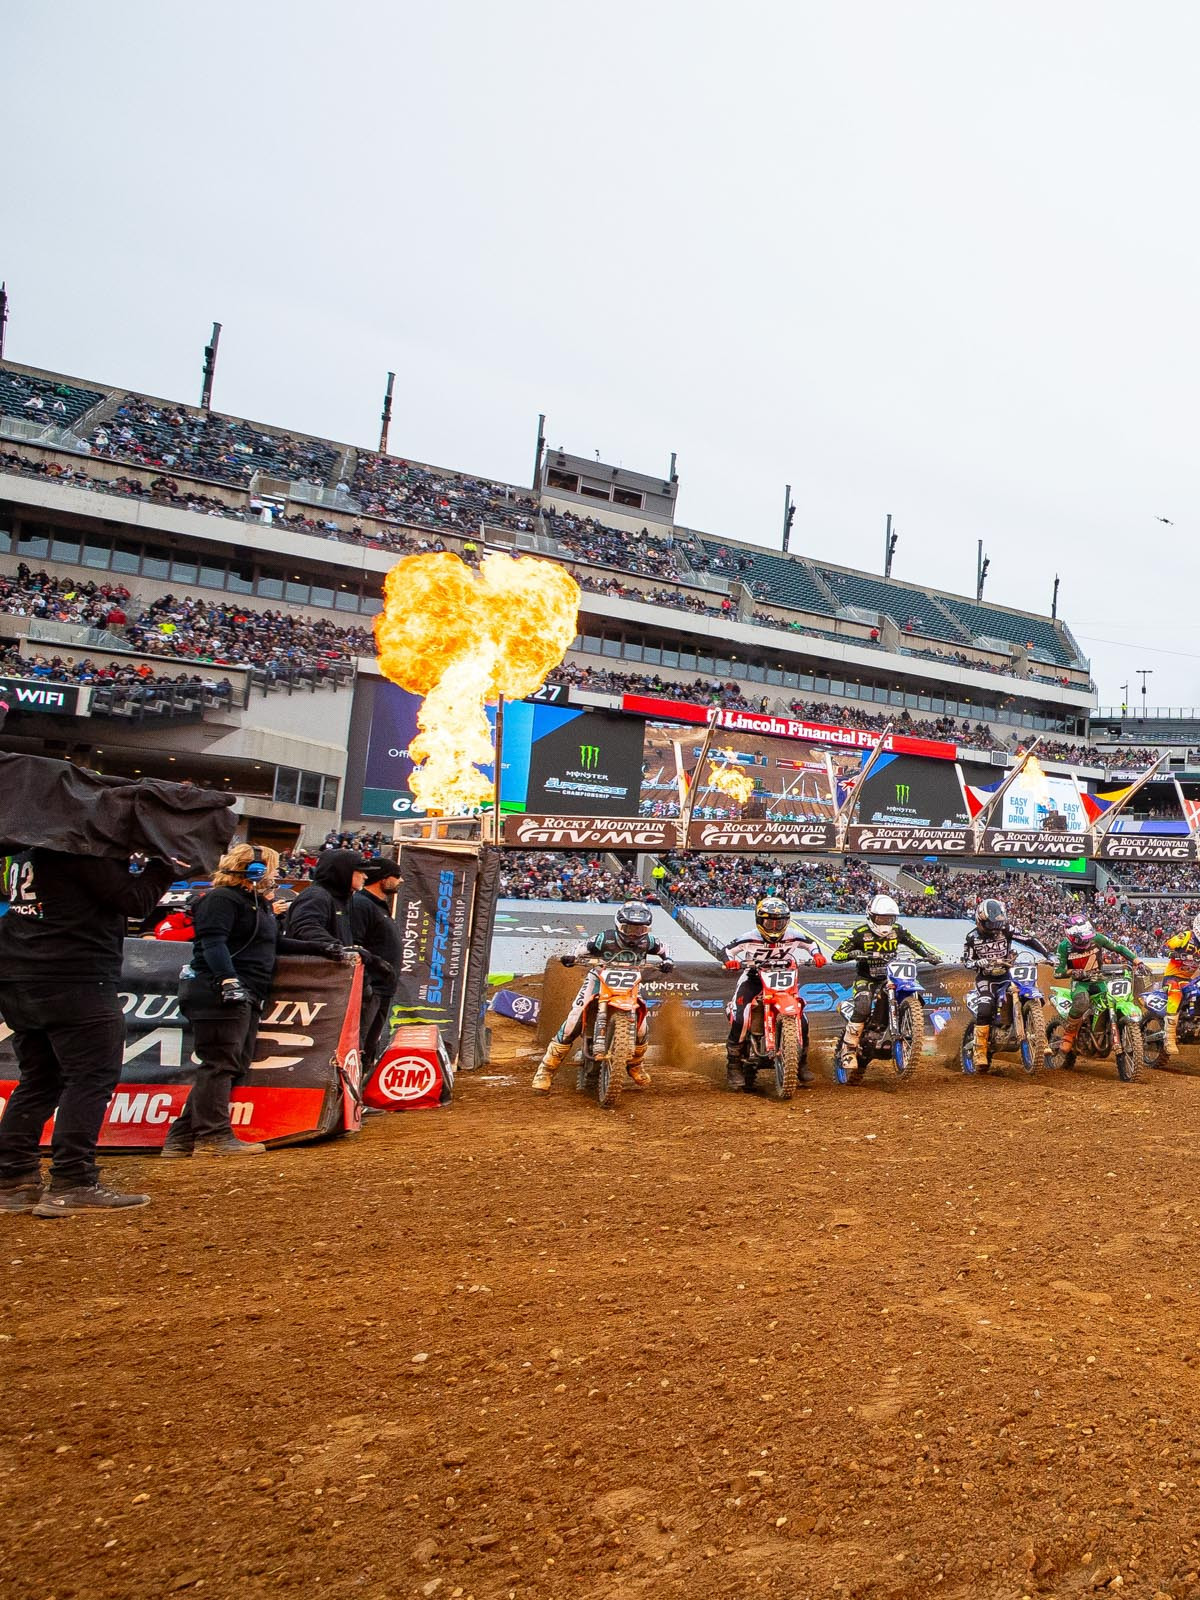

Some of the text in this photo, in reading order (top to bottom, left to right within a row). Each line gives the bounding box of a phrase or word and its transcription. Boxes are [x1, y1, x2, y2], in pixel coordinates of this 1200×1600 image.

[16, 688, 65, 706] WIFI
[724, 711, 786, 734] Lincoln
[787, 721, 856, 744] Financial
[562, 789, 610, 799] CHAMPIONSHIP
[1010, 796, 1028, 807] EASY
[1064, 803, 1080, 812] EASY
[1015, 806, 1024, 815] TO
[1008, 815, 1029, 824] DRINK
[1068, 813, 1076, 821] TO
[541, 817, 665, 832] ROCKY MOUNTAIN
[722, 822, 826, 833] ROCKY MOUNTAIN
[876, 828, 966, 839] ROCKY MOUNTAIN
[1007, 832, 1085, 843] ROCKY MOUNTAIN
[1121, 838, 1189, 848] ROCKY MOUNTAIN
[401, 900, 422, 972] MONSTER
[419, 911, 430, 961] ENERGY
[450, 899, 467, 976] CHAMPIONSHIP
[864, 940, 898, 952] FXR
[753, 948, 792, 960] FLY
[893, 964, 915, 979] 70
[1014, 967, 1036, 980] 91
[605, 971, 637, 988] 62
[768, 972, 793, 988] 15
[418, 984, 428, 1001] AMA
[639, 981, 700, 992] MONSTER
[1111, 981, 1128, 996] 81
[1150, 996, 1167, 1009] 23
